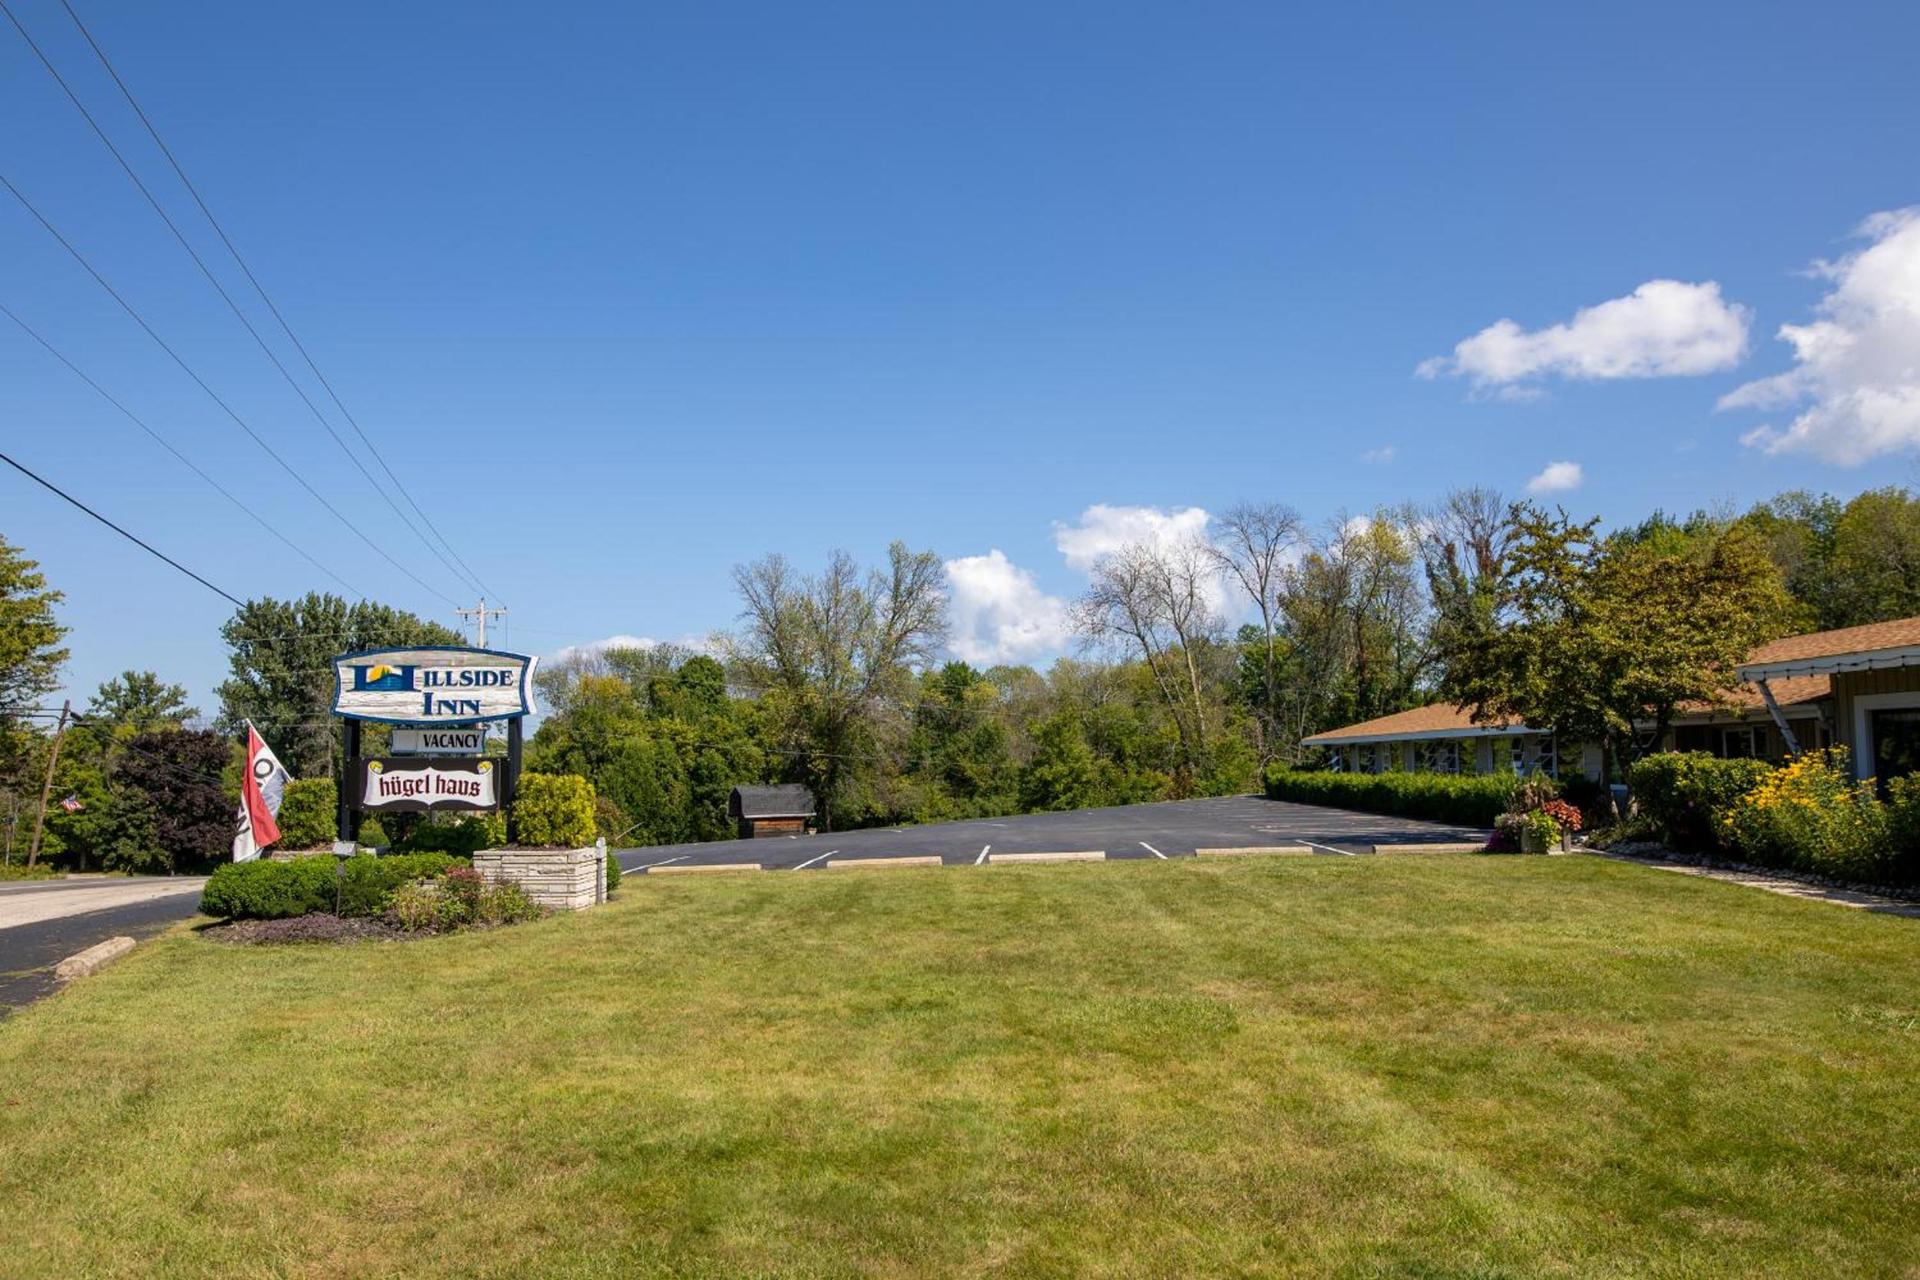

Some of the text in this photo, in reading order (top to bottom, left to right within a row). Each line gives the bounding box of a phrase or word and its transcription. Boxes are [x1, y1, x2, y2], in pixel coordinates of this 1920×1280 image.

[346, 665, 514, 692] HILLSIDE
[424, 692, 481, 715] INN
[423, 734, 480, 748] VACANCY
[379, 775, 481, 797] hügel haus
